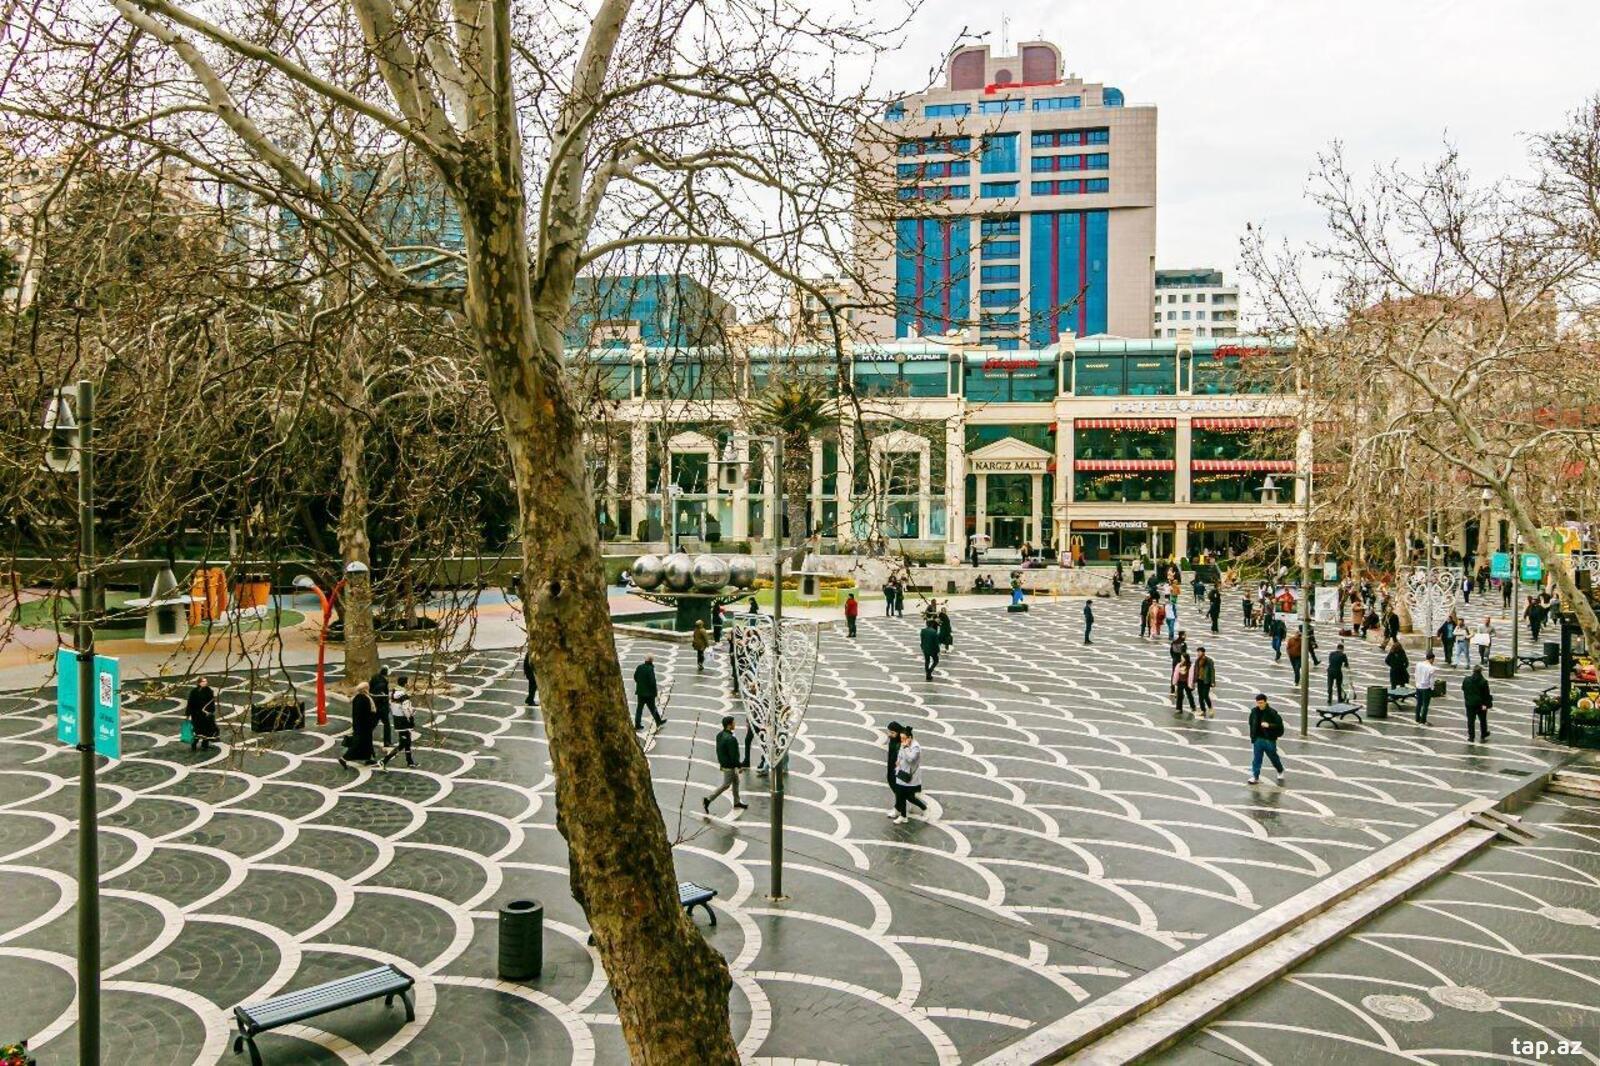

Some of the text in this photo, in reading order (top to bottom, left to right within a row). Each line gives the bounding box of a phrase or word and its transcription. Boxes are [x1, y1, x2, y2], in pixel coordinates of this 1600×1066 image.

[1112, 401, 1174, 413] HAPPY
[975, 461, 1042, 471] NARGIZ MALL
[1098, 520, 1148, 529] McDonald's
